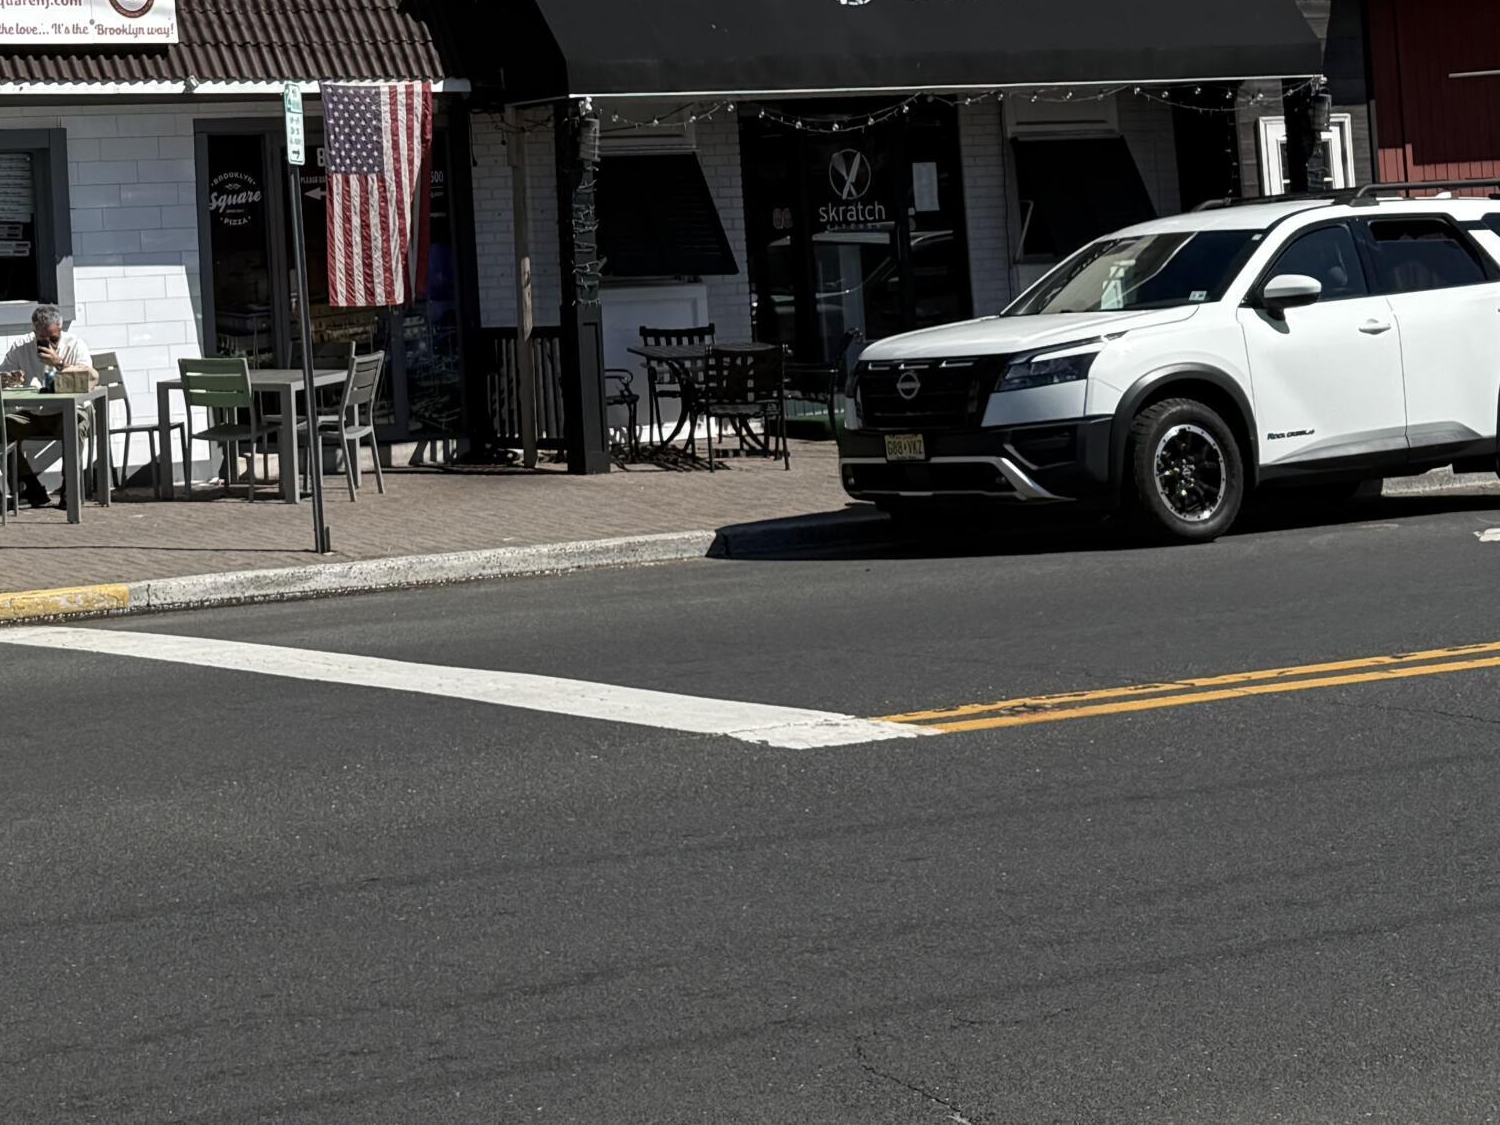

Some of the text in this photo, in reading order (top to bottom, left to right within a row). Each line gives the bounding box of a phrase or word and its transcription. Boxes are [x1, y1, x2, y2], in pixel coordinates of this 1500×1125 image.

[72, 24, 89, 36] the
[147, 24, 175, 38] way!
[205, 190, 262, 213] Square
[818, 200, 886, 222] skratch
